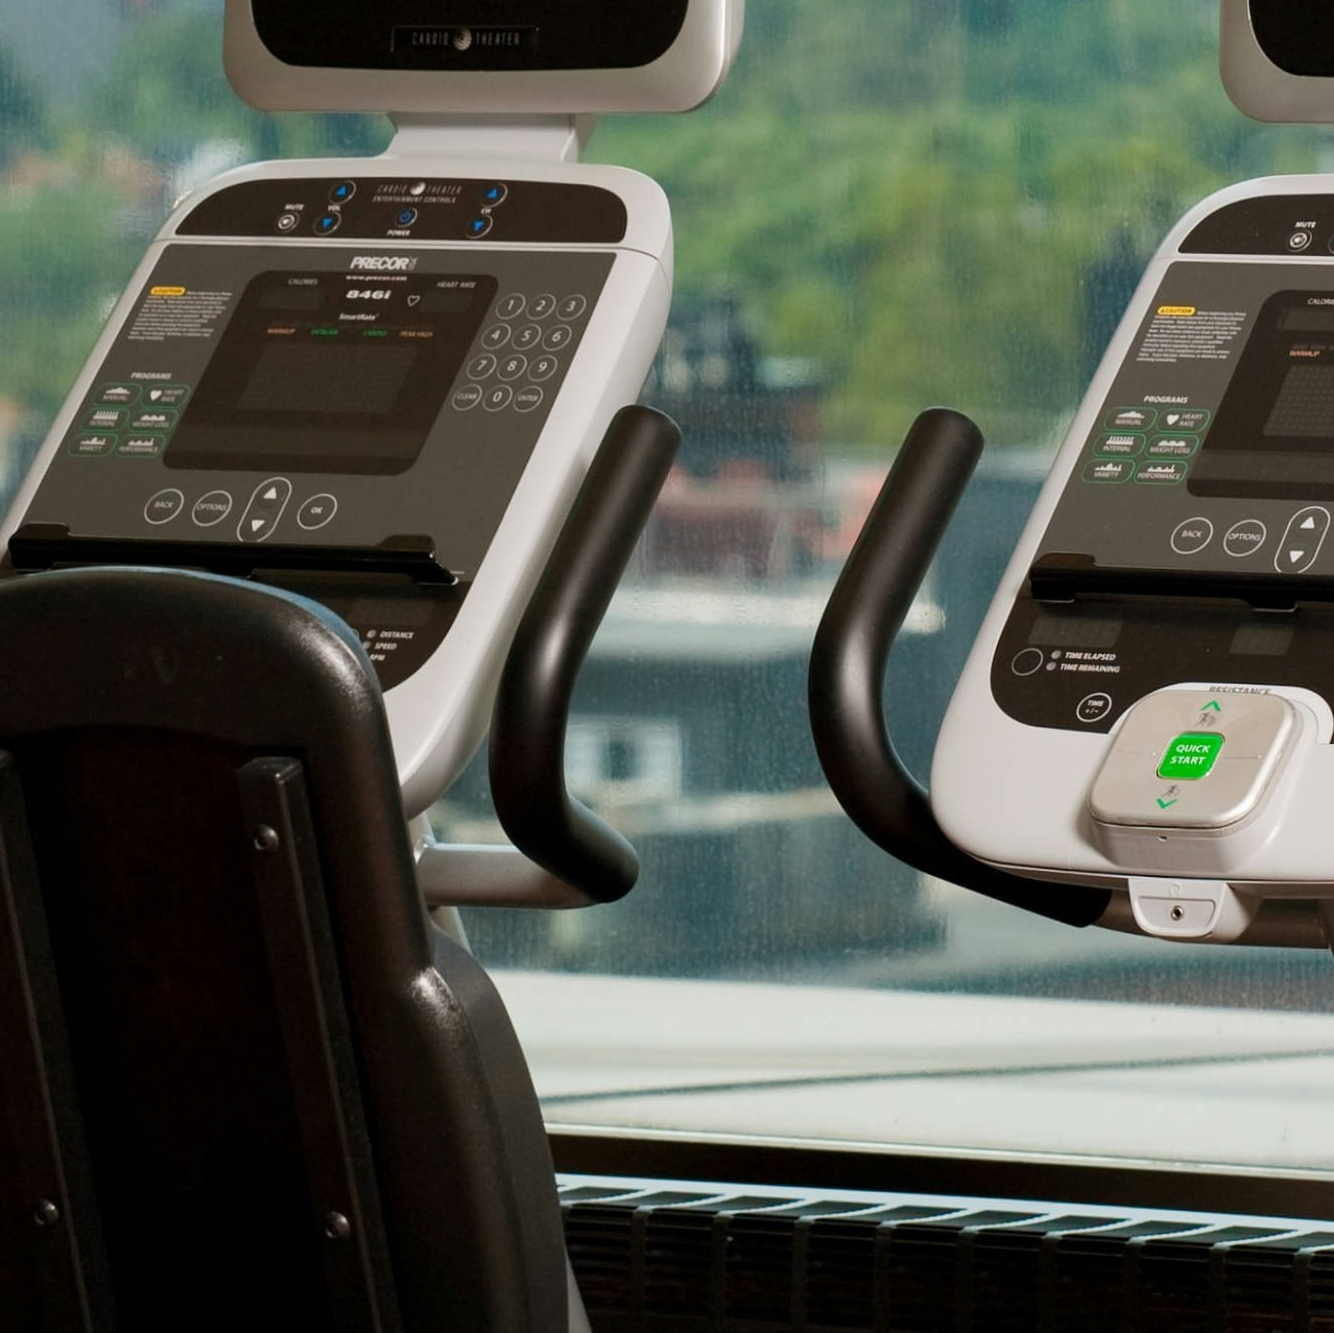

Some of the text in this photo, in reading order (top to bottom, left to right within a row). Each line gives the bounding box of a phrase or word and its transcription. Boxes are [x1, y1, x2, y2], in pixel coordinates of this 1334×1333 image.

[412, 32, 520, 46] CARDIO THEATER
[387, 229, 411, 237] POWER
[350, 256, 409, 270] PRECOR
[507, 300, 515, 310] 1
[535, 300, 547, 311] 2
[566, 300, 577, 312] 3
[491, 330, 501, 340] 4
[521, 330, 532, 342] 5
[551, 331, 563, 342] 6
[477, 360, 487, 371] 7
[507, 360, 517, 372] 8
[537, 362, 547, 373] 9
[131, 372, 172, 380] PROGRAMS
[493, 392, 503, 403] 0
[1143, 395, 1189, 404] PROGRAMS
[1149, 446, 1173, 454] WEIGHT
[1137, 472, 1181, 480] PERFORMANCE
[196, 503, 227, 512] OPTIONS
[310, 506, 323, 514] OK
[1181, 530, 1203, 539] BACK
[1227, 532, 1261, 542] OPTIONS
[379, 630, 415, 639] DISTANCE
[375, 642, 398, 650] SPEED
[1065, 651, 1117, 661] TIME ELAPSED
[1060, 663, 1121, 674] TIME REMAINING
[1209, 686, 1271, 696] RESISTANCE
[1175, 744, 1211, 754] QUICK
[1170, 756, 1207, 765] START
